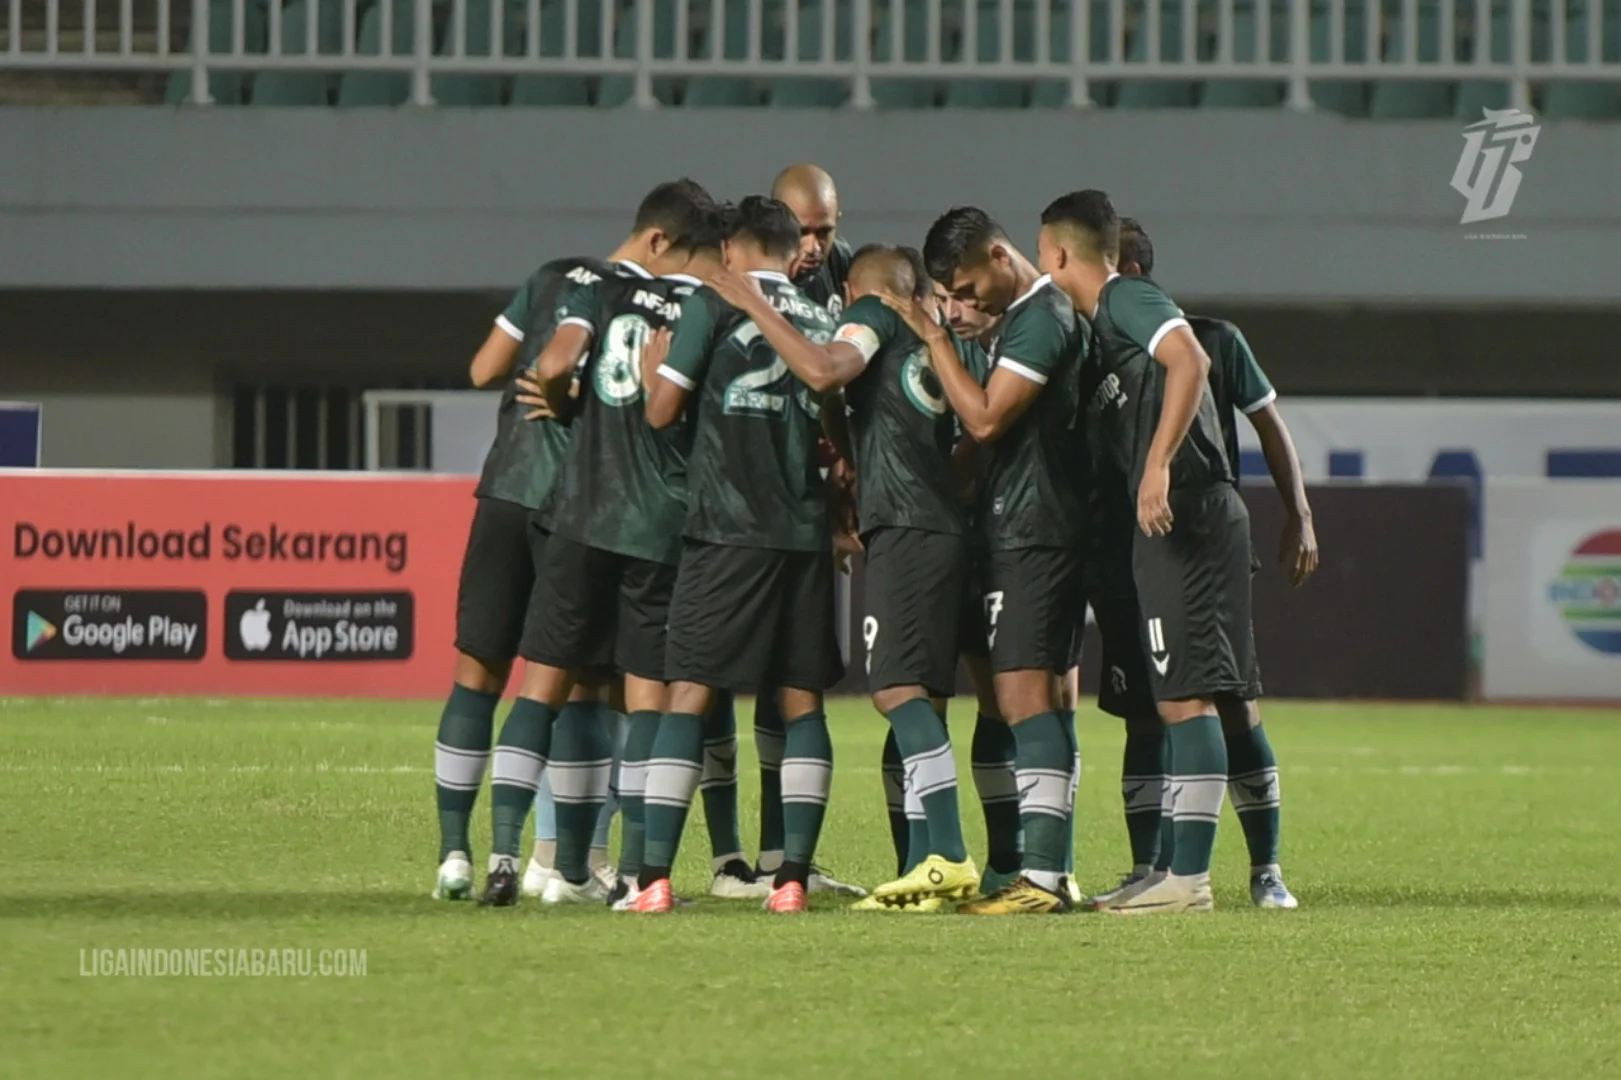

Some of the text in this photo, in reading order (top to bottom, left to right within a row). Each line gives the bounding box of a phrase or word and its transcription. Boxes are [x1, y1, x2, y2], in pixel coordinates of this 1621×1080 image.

[14, 521, 407, 573] Download Sekarang
[65, 595, 121, 613] GET IT ON
[283, 599, 397, 618] Download on the
[63, 615, 197, 654] Google Play
[282, 620, 398, 659] App Store
[862, 615, 879, 651] 9
[1147, 617, 1166, 653] 11
